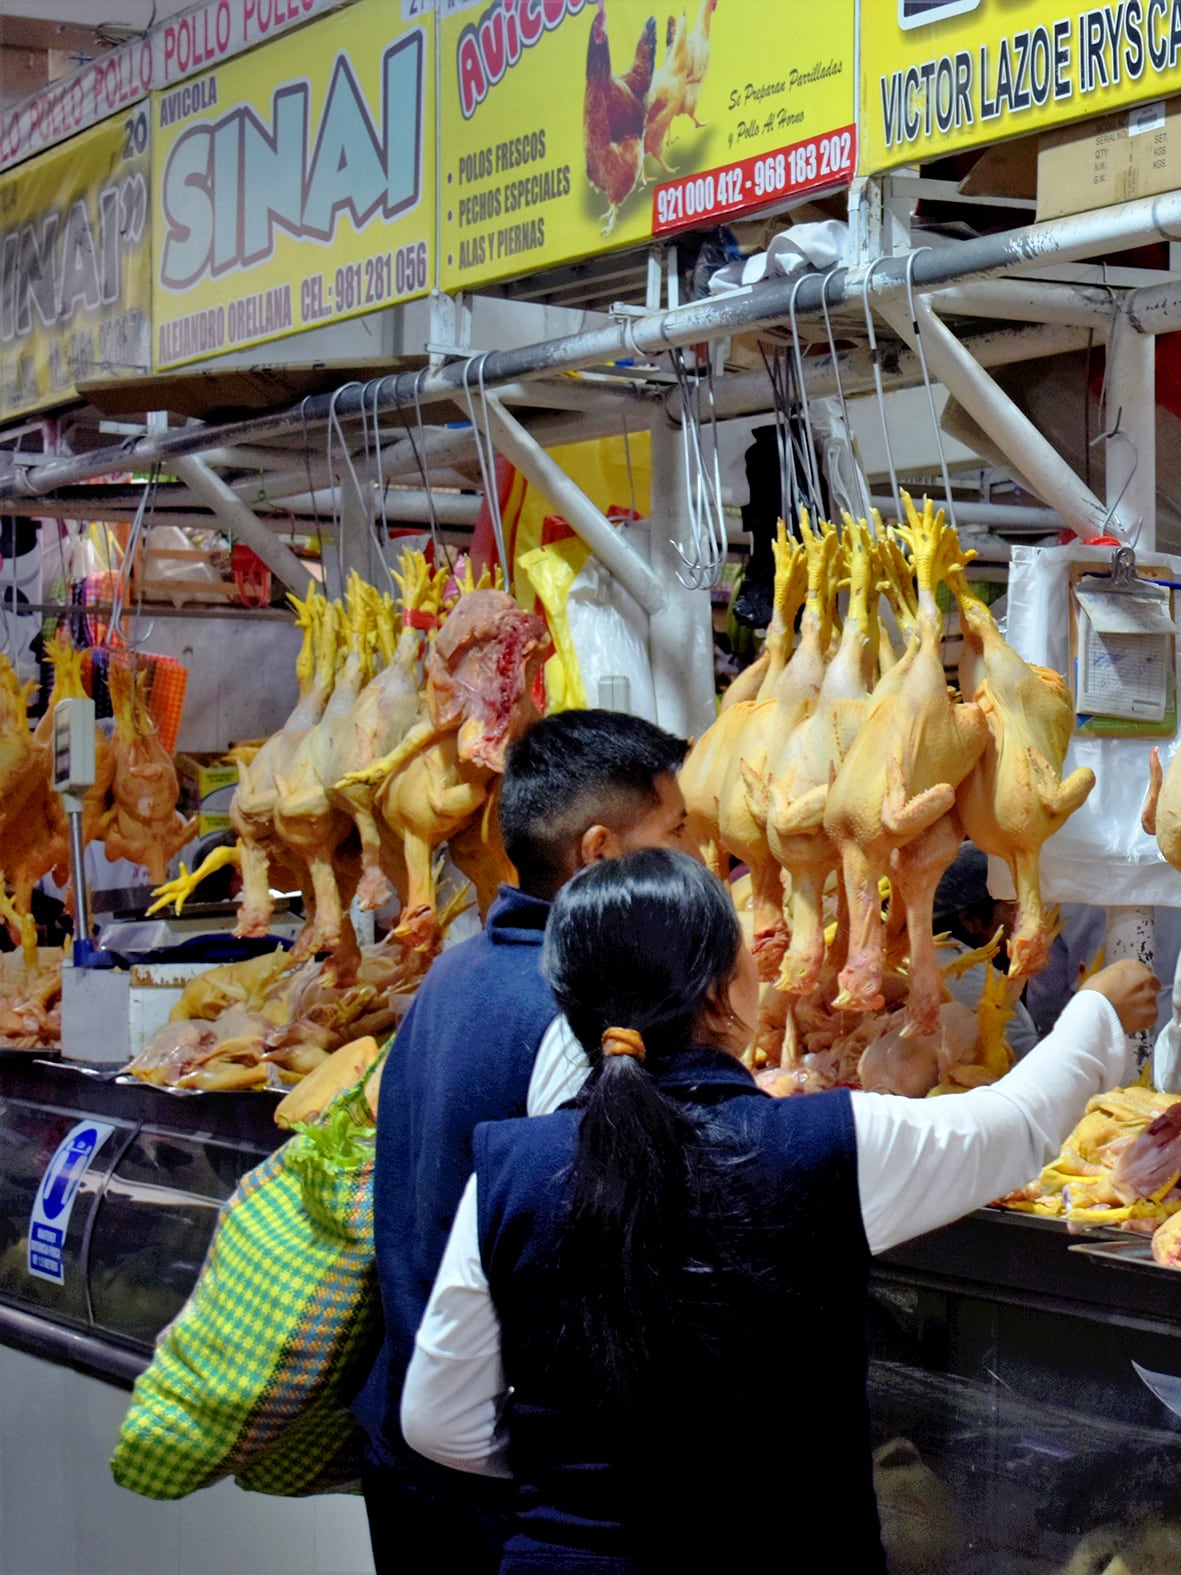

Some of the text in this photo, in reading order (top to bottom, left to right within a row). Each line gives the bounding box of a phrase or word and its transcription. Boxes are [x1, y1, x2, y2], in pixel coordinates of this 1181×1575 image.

[93, 39, 153, 115] POLLO
[164, 0, 231, 80] POLLO
[744, 83, 786, 106] Preparan
[789, 58, 843, 92] Parrilladas
[160, 76, 218, 128] AVICOLA
[880, 51, 974, 147] VICTOR
[122, 111, 147, 160] 20
[162, 29, 424, 290] SINAI
[459, 129, 546, 186] POLOS FRESCOS
[737, 118, 760, 144] Pollo
[459, 165, 570, 228] PECHOS ESPECIALES
[657, 184, 684, 224] 921
[685, 175, 714, 216] 000
[717, 167, 743, 206] 412
[754, 153, 785, 196] 968
[788, 143, 817, 185] 183
[820, 132, 851, 176] 202
[459, 217, 545, 270] ALAS Y PIERNAS
[158, 306, 225, 364] ALEJANDRO
[228, 285, 292, 344] ORELLANA
[335, 263, 362, 314] 981
[365, 253, 392, 301] 281
[395, 242, 427, 295] 056
